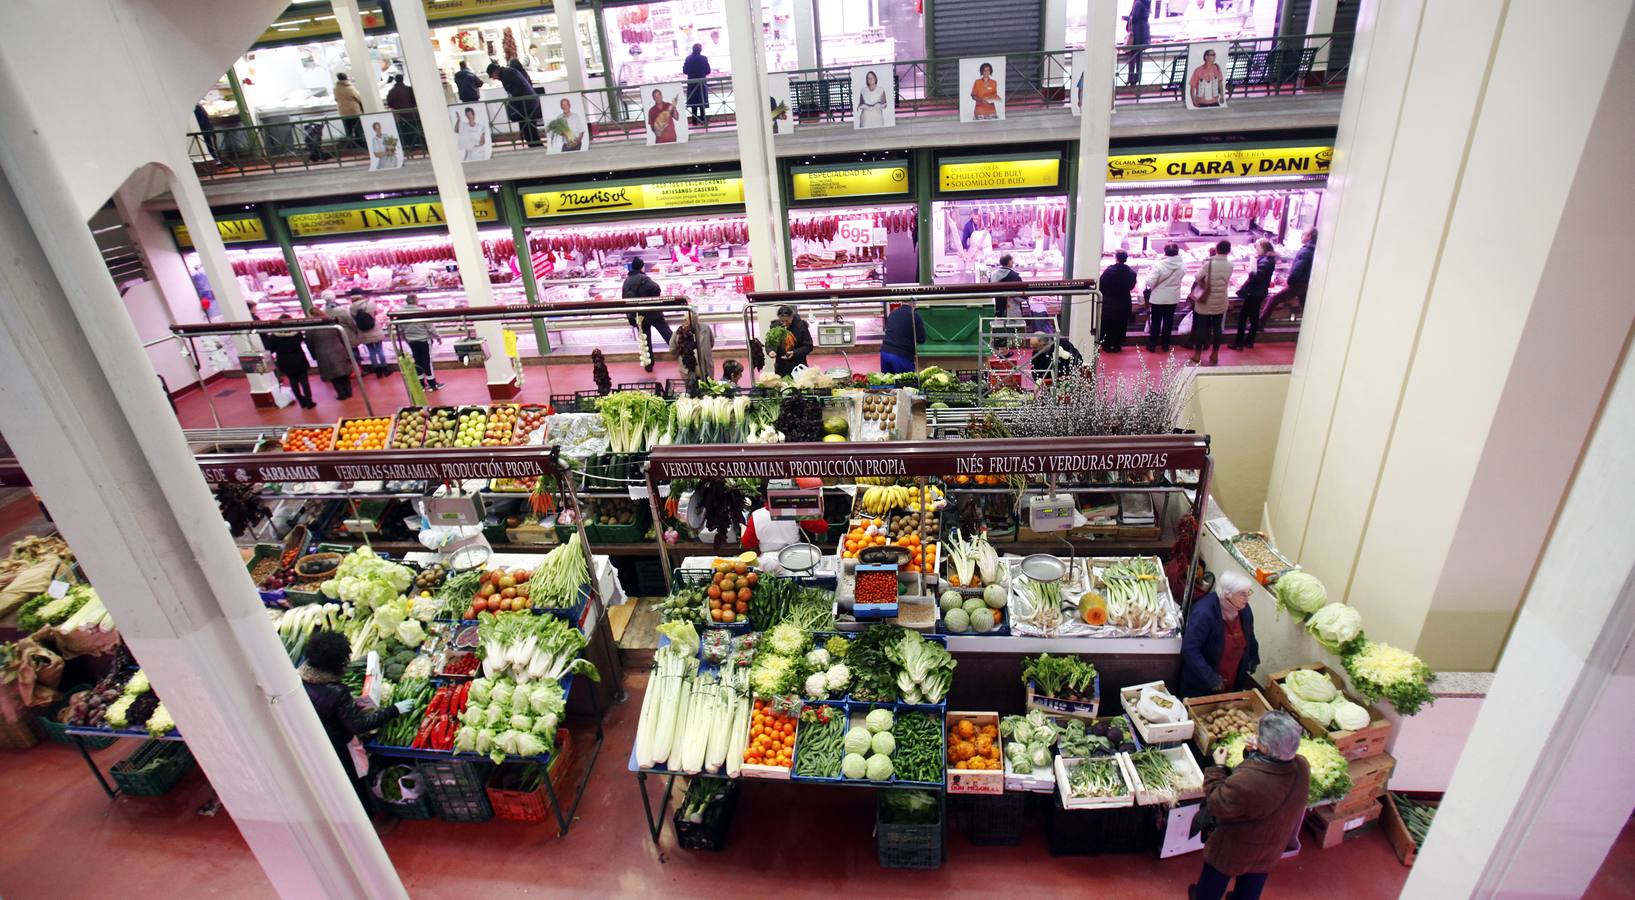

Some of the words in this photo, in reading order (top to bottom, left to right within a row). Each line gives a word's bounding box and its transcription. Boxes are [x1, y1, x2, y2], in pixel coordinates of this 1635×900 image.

[809, 169, 860, 180] ESPECIALIDAD
[1166, 160, 1235, 175] CLARA
[1240, 163, 1253, 176] y
[1259, 157, 1310, 172] DANI
[951, 179, 994, 187] SOLOMILLO
[560, 188, 630, 207] Marisol
[360, 204, 444, 228] INMA
[334, 464, 383, 480] VERDURAS
[382, 464, 442, 480] SARRAMIAN,
[441, 458, 505, 478] PRODUCCIÓN
[506, 461, 544, 476] PROPIA
[661, 462, 718, 478] VERDURAS
[719, 461, 788, 478] SARRAMIAN,
[790, 456, 864, 476] PRODUCCIÓN
[866, 459, 906, 474] PROPIA
[956, 454, 984, 473] INÉS
[990, 456, 1035, 472] FRUTAS
[1038, 456, 1047, 472] Y
[1049, 454, 1114, 472] VERDURAS
[1116, 453, 1168, 469] PROPIAS
[212, 468, 228, 482] DE
[259, 466, 320, 480] SARRAMIAN
